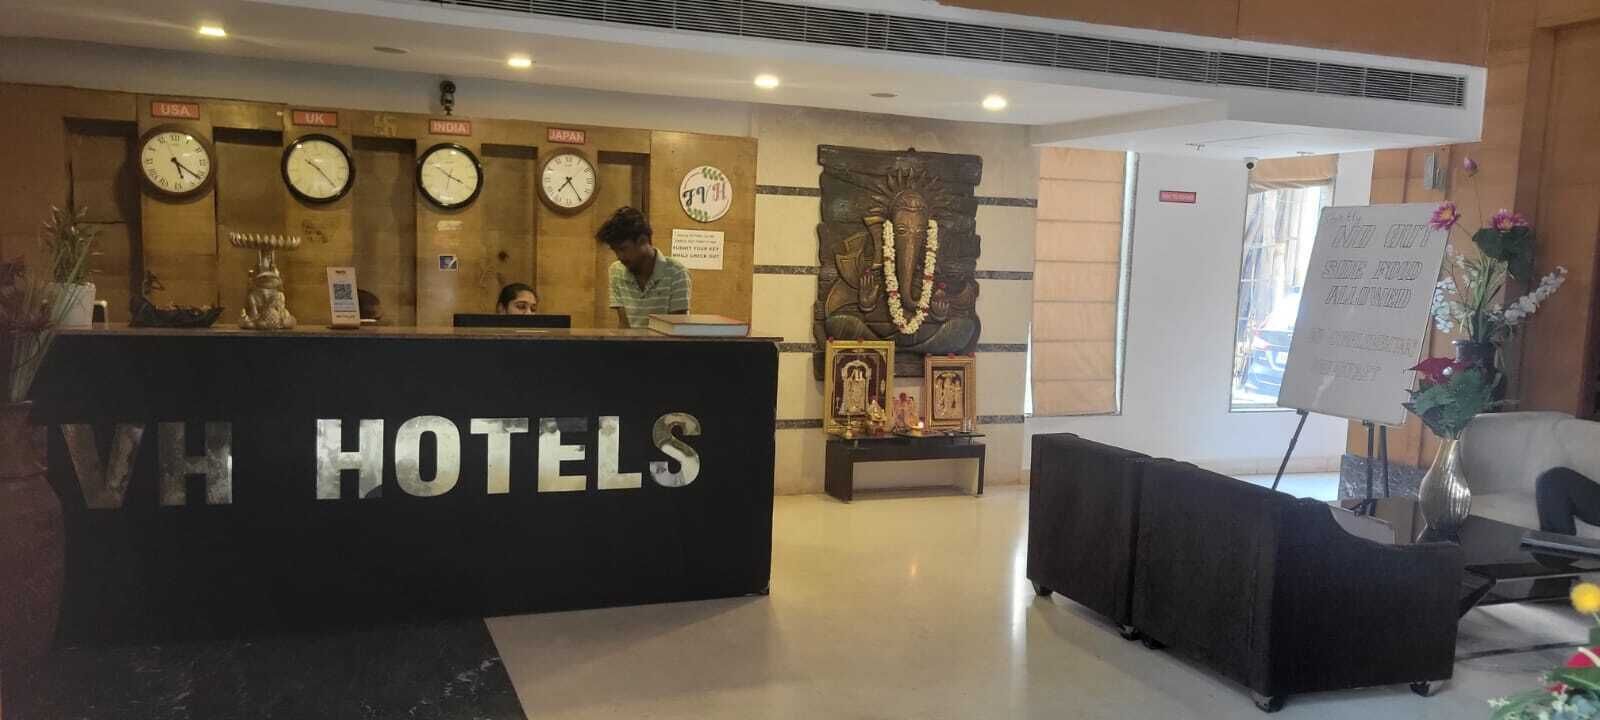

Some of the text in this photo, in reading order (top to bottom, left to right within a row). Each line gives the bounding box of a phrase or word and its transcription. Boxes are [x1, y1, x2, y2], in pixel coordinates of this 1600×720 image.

[160, 104, 191, 117] USA
[305, 112, 325, 124] UK
[432, 121, 467, 133] INDIA
[549, 129, 585, 142] JAPAN
[1322, 259, 1423, 281] SIDE FOOD
[1325, 284, 1412, 309] ALLOWED
[315, 412, 701, 500] HOTELS
